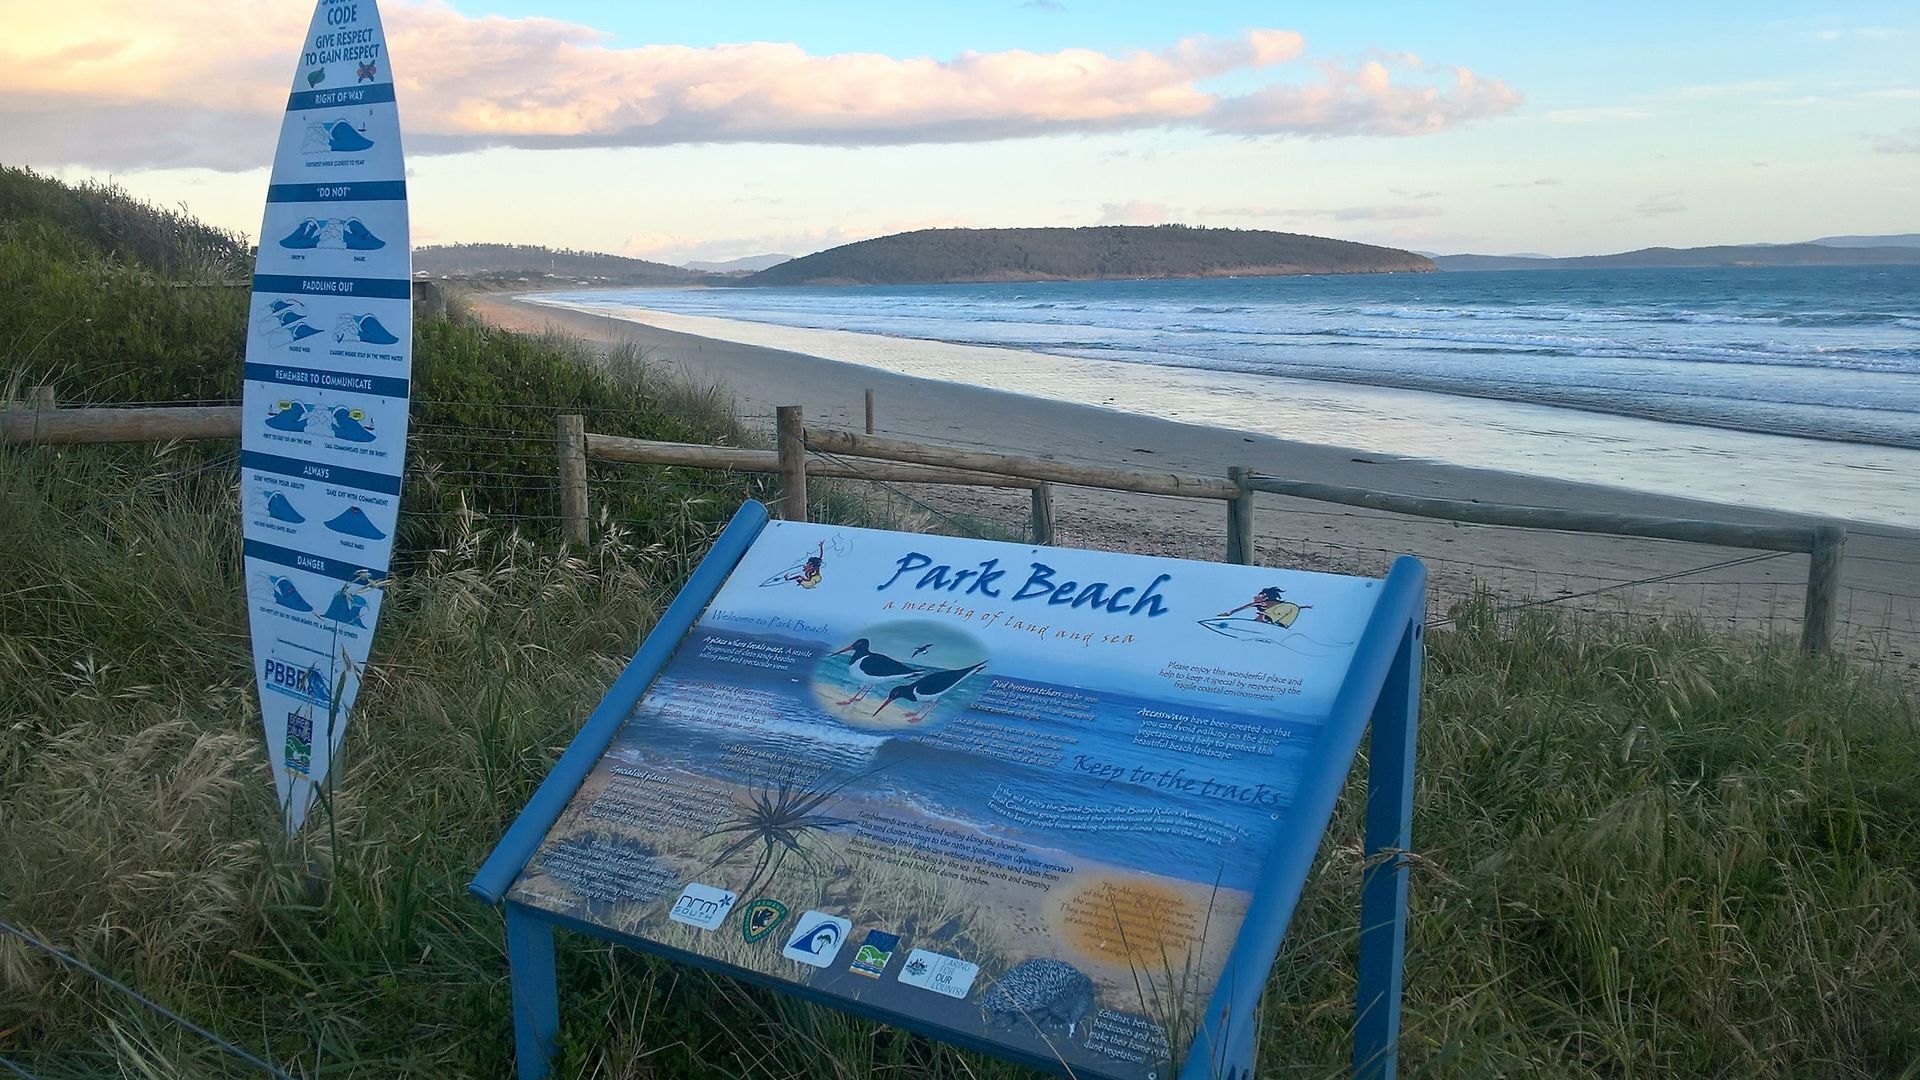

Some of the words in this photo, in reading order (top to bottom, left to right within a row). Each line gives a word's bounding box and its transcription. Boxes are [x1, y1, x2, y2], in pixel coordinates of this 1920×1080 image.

[327, 4, 358, 26] CODE
[316, 31, 335, 49] GIVE
[336, 28, 373, 45] RESPECT
[305, 52, 317, 66] TO
[319, 48, 341, 64] GAIN
[343, 43, 380, 62] RESPECT
[315, 92, 335, 105] RIGHT
[338, 91, 347, 102] OF
[349, 90, 364, 101] WAY
[302, 280, 337, 292] PADDLING
[338, 282, 353, 293] OUT
[275, 369, 309, 383] REMEMBER
[310, 373, 320, 385] TO
[321, 374, 372, 390] COMMUNICATE
[303, 465, 330, 479] ALWAYS
[297, 556, 325, 572] DANGER
[877, 551, 1006, 599] Park
[1011, 561, 1172, 618] Beach
[712, 609, 755, 623] Welcome
[768, 616, 791, 628] Park
[793, 619, 829, 633] Beach
[883, 602, 893, 611] a
[902, 600, 974, 620] meeting
[981, 611, 1001, 628] of
[1004, 616, 1050, 640] land
[1056, 629, 1095, 647] and
[1101, 633, 1135, 644] sea
[1136, 707, 1189, 725] Accessways
[1190, 715, 1209, 726] have
[1209, 718, 1230, 728] been
[1231, 723, 1262, 733] created
[1262, 727, 1273, 735] so
[1274, 727, 1291, 737] that
[1138, 729, 1179, 740] vegetation
[1180, 735, 1195, 743] and
[1196, 735, 1214, 748] help
[1215, 739, 1225, 747] to
[1225, 742, 1256, 753] protect
[1257, 745, 1273, 755] this
[1140, 720, 1158, 728] you
[1159, 722, 1173, 730] can
[1173, 724, 1196, 734] avoid
[1196, 727, 1228, 740] walking
[1242, 733, 1257, 743] the
[1257, 736, 1280, 746] dune
[1133, 736, 1169, 749] beautiful
[1168, 742, 1192, 753] beach
[1073, 754, 1126, 789] Keep
[1129, 765, 1154, 784] to
[1156, 769, 1196, 792] the
[1200, 777, 1283, 806] tracks
[674, 906, 714, 920] SOUTH
[935, 973, 953, 984] OUR
[931, 982, 965, 997] COUNTRY
[1093, 1018, 1133, 1036] bandicoots
[1133, 1032, 1149, 1041] and
[1084, 1039, 1104, 1053] dune
[1089, 1031, 1109, 1042] make
[1110, 1035, 1128, 1046] their
[1128, 1039, 1151, 1053] home
